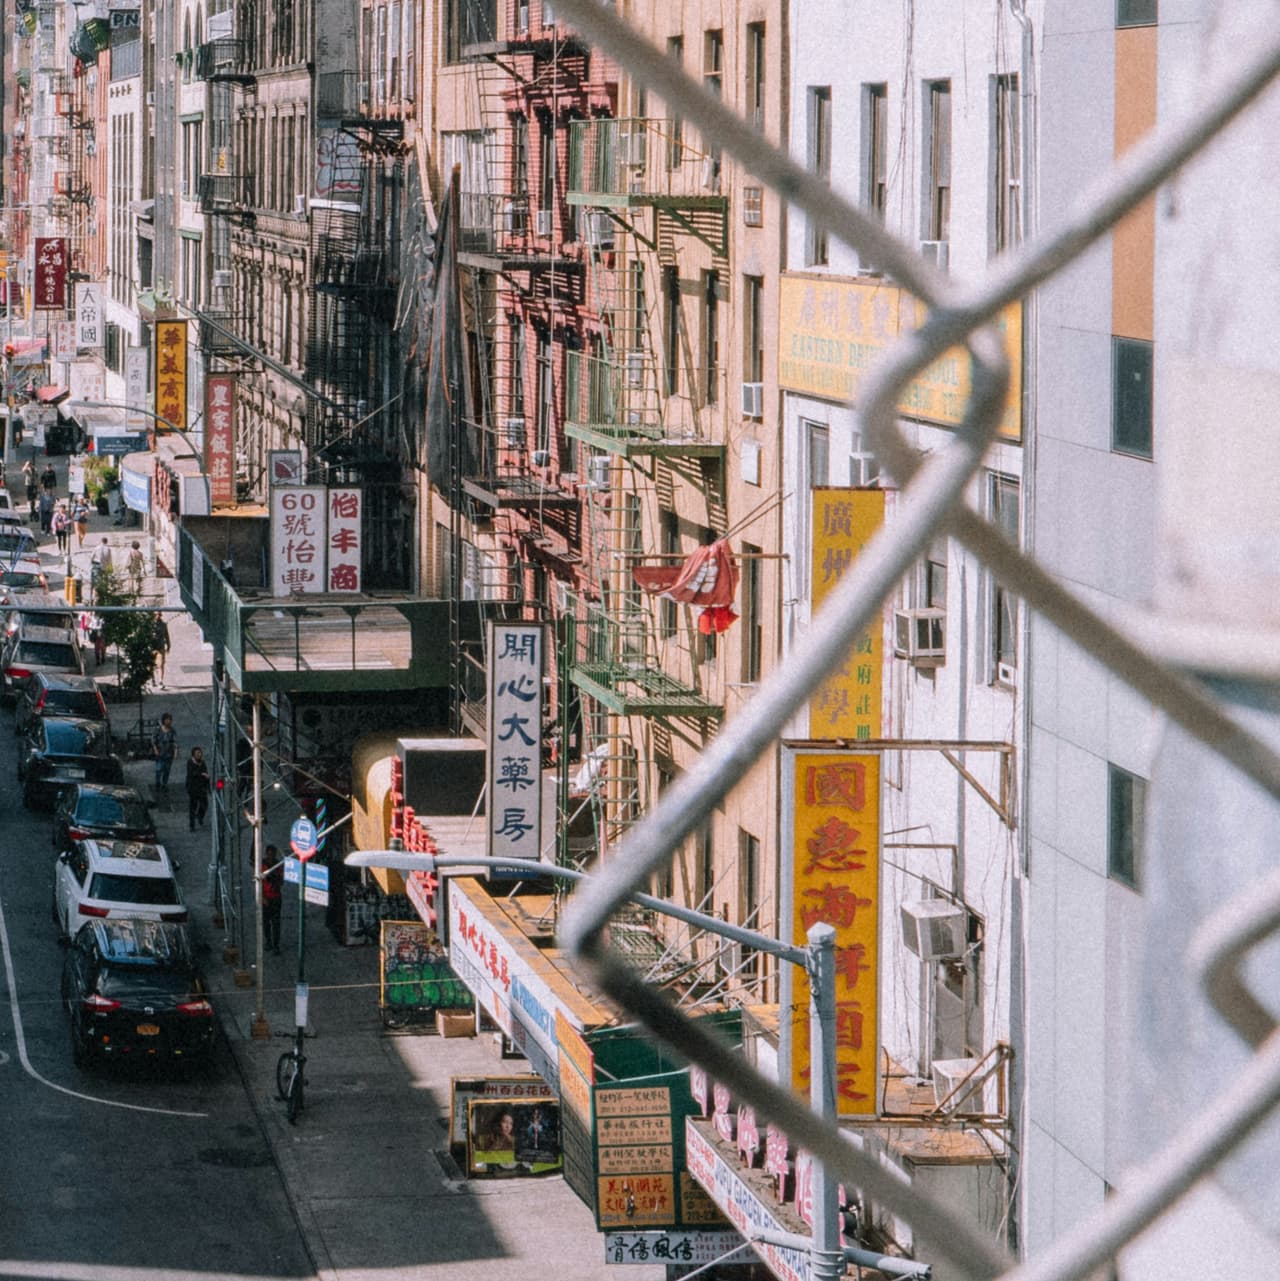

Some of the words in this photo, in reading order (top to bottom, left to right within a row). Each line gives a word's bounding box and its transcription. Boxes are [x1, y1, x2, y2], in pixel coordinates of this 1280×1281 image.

[495, 632, 537, 843] 開心大藥房
